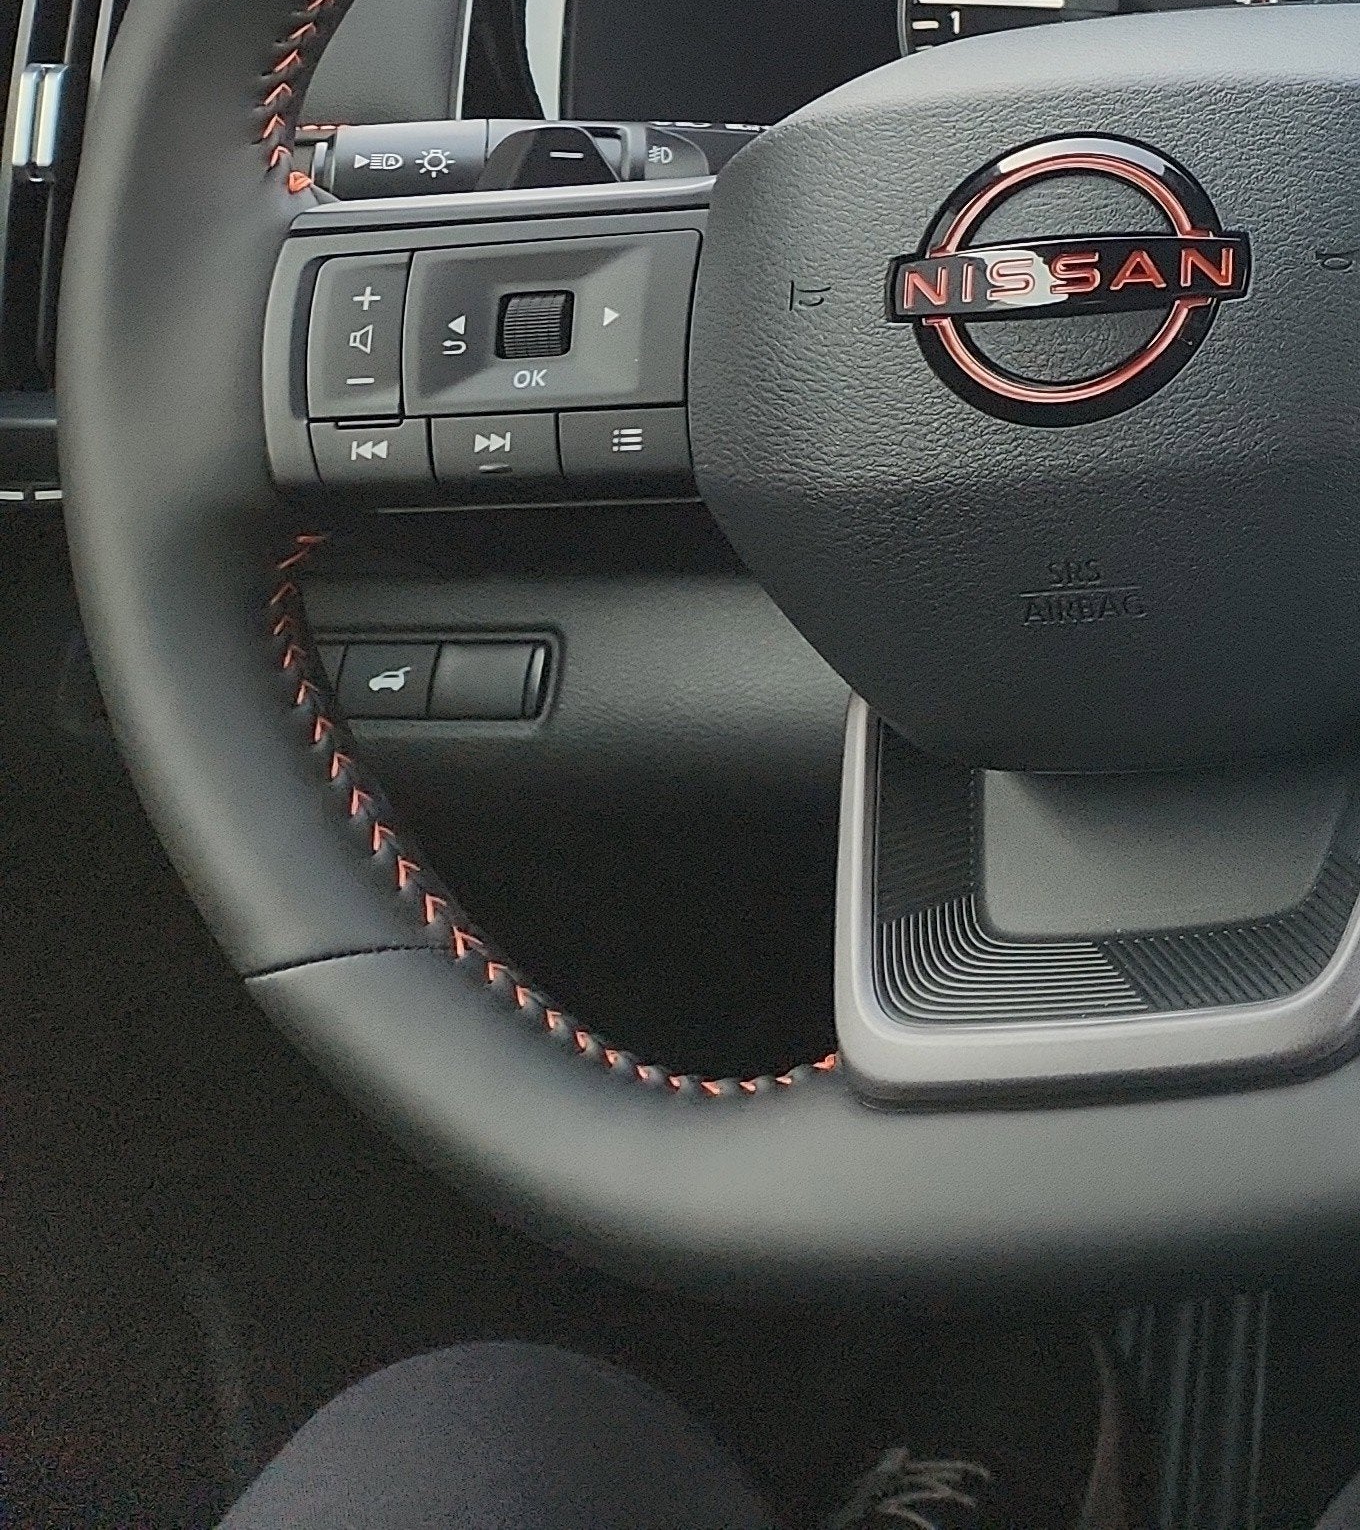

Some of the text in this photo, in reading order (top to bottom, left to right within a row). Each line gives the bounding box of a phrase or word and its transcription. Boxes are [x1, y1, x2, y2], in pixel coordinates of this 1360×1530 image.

[949, 10, 961, 34] 1
[903, 246, 1234, 311] NISSAN
[513, 369, 548, 389] OK
